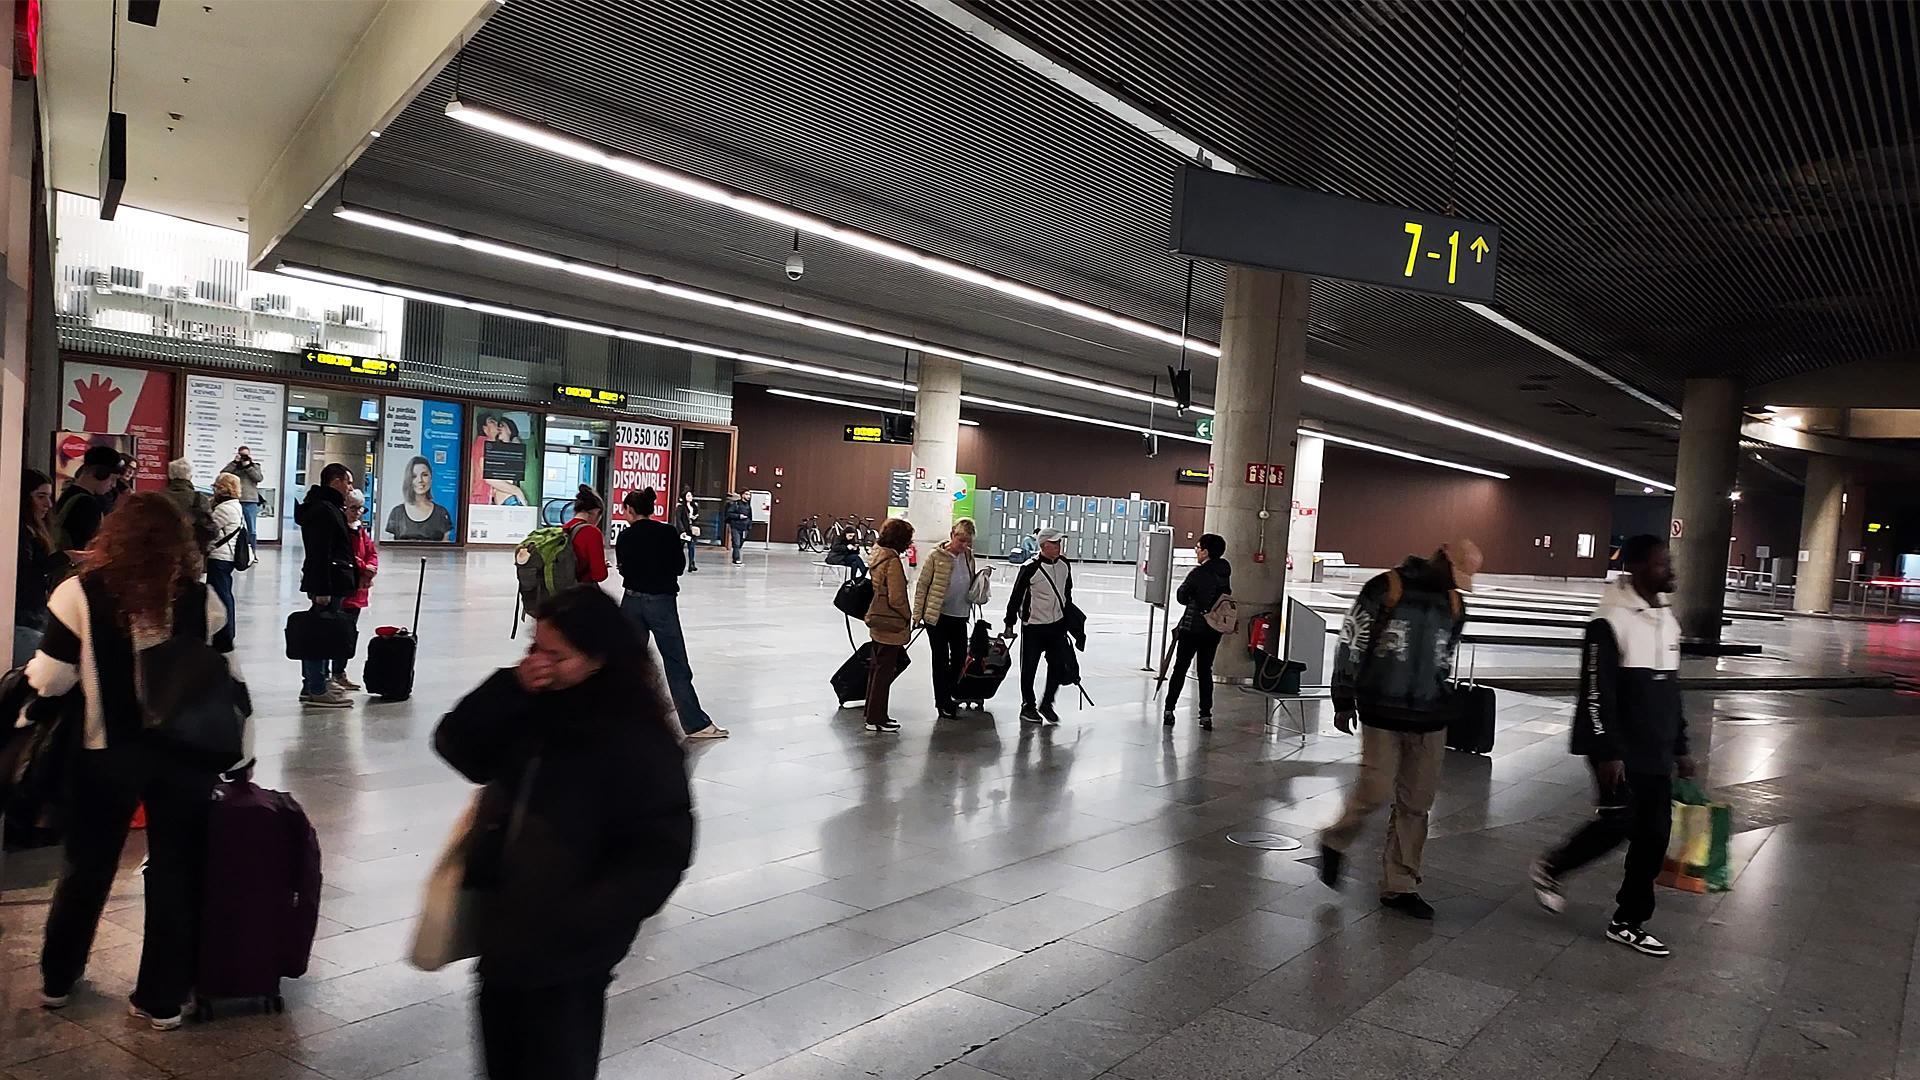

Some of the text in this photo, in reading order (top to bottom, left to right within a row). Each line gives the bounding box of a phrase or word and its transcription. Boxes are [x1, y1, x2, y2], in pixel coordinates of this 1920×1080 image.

[190, 382, 222, 391] LIMPIEZAS
[634, 427, 651, 446] 550
[653, 430, 669, 448] 165
[622, 450, 660, 472] ESPACIO
[613, 470, 667, 492] DISPONIBLE
